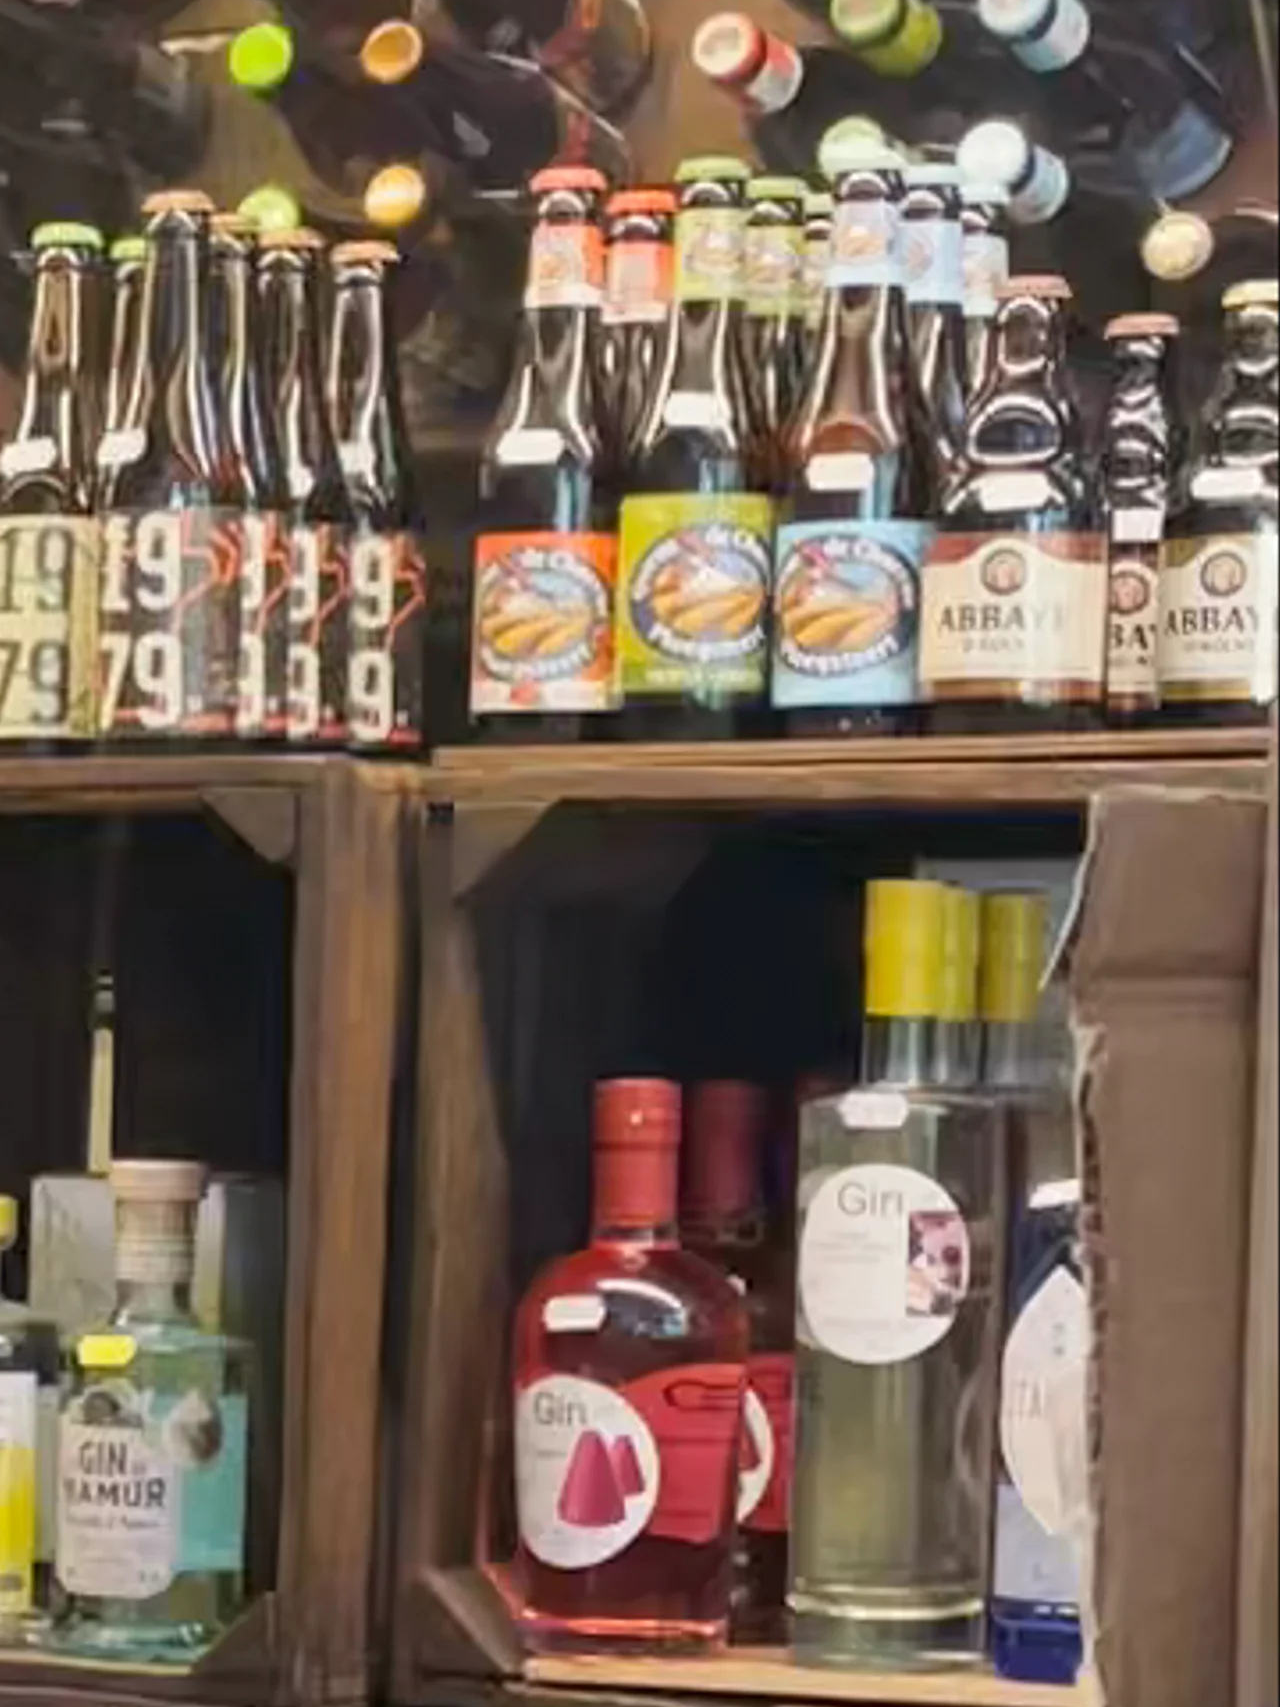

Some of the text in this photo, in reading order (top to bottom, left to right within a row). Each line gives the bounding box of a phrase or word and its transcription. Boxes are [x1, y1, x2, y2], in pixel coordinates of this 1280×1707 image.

[1163, 605, 1260, 637] ABBAY
[836, 1180, 905, 1218] Gin
[532, 1392, 588, 1426] Gin
[78, 1441, 127, 1476] GIN
